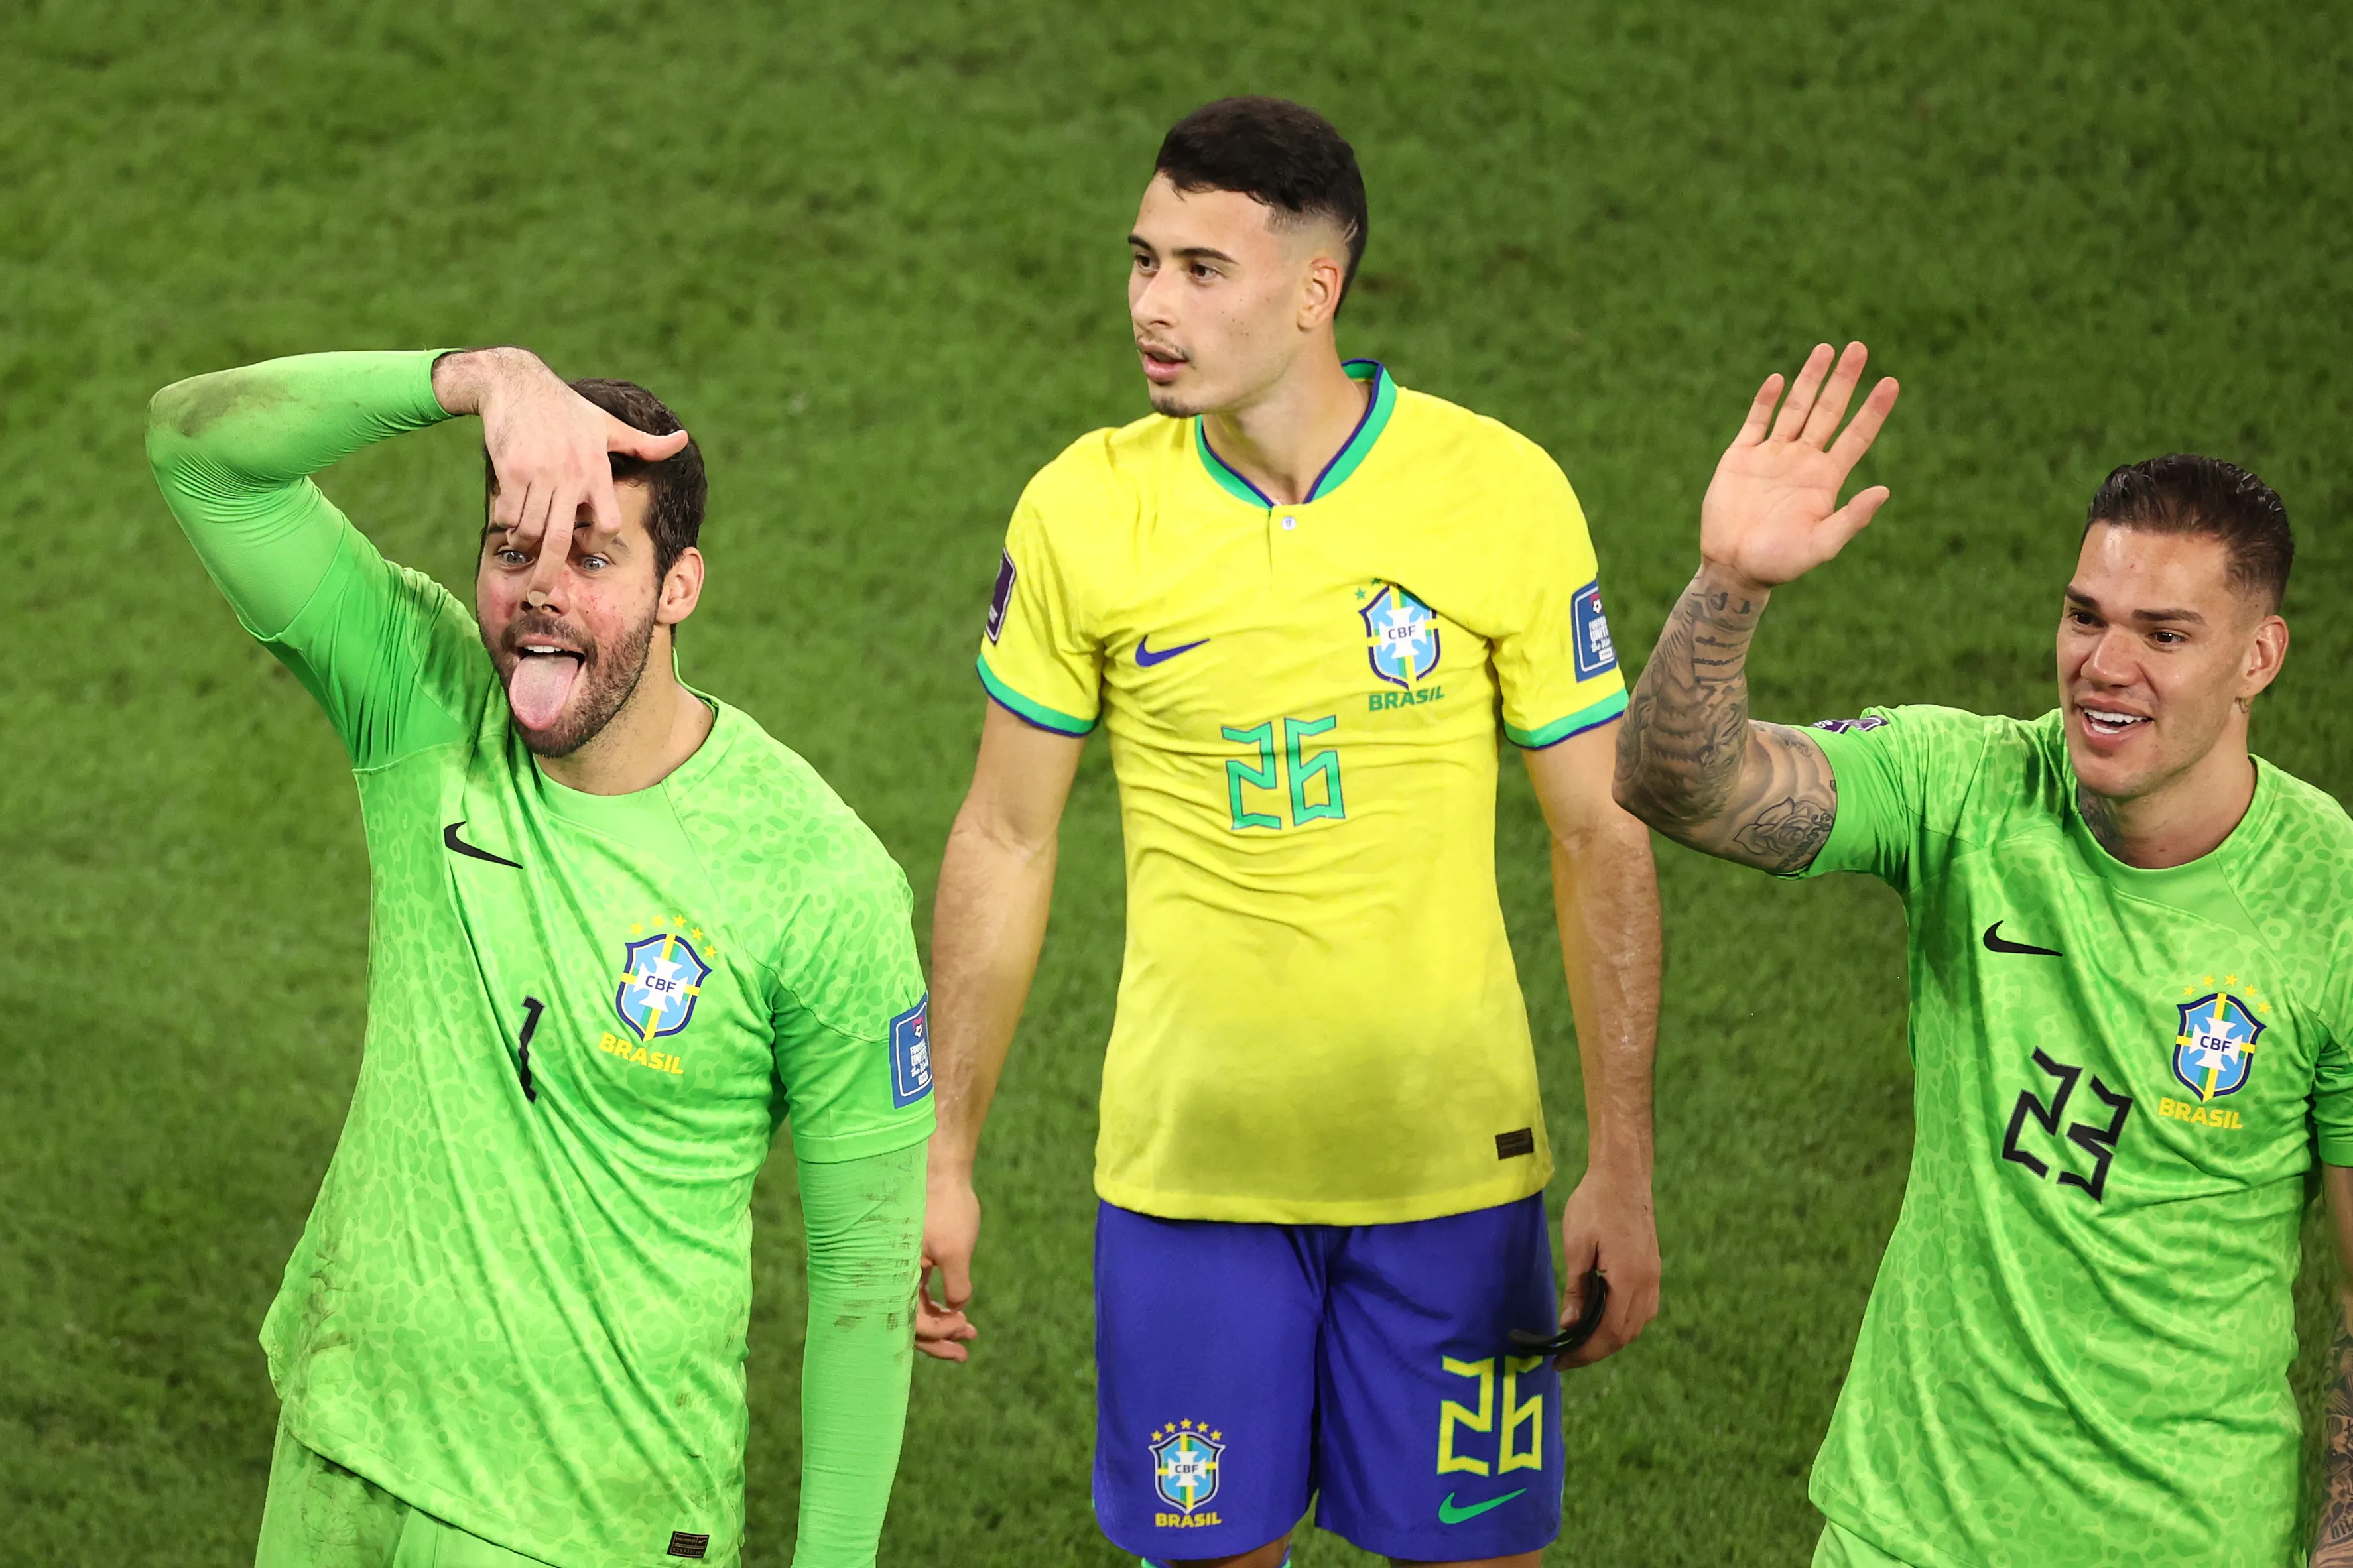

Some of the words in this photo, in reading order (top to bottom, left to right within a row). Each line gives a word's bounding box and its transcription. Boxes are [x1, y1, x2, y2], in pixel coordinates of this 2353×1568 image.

[1387, 625, 1416, 640] CBF
[1368, 685, 1444, 711] BRASIL
[1220, 715, 1346, 831] 26
[645, 975, 676, 993] CBF
[518, 995, 546, 1105] 1
[598, 1031, 684, 1075] BRASIL
[2199, 1034, 2232, 1053] CBF
[2002, 1046, 2133, 1204] 23
[2157, 1097, 2244, 1130] BRASIL
[1436, 1355, 1543, 1477] 26
[1175, 1464, 1198, 1473] CBF
[1155, 1512, 1222, 1528] BRASIL
